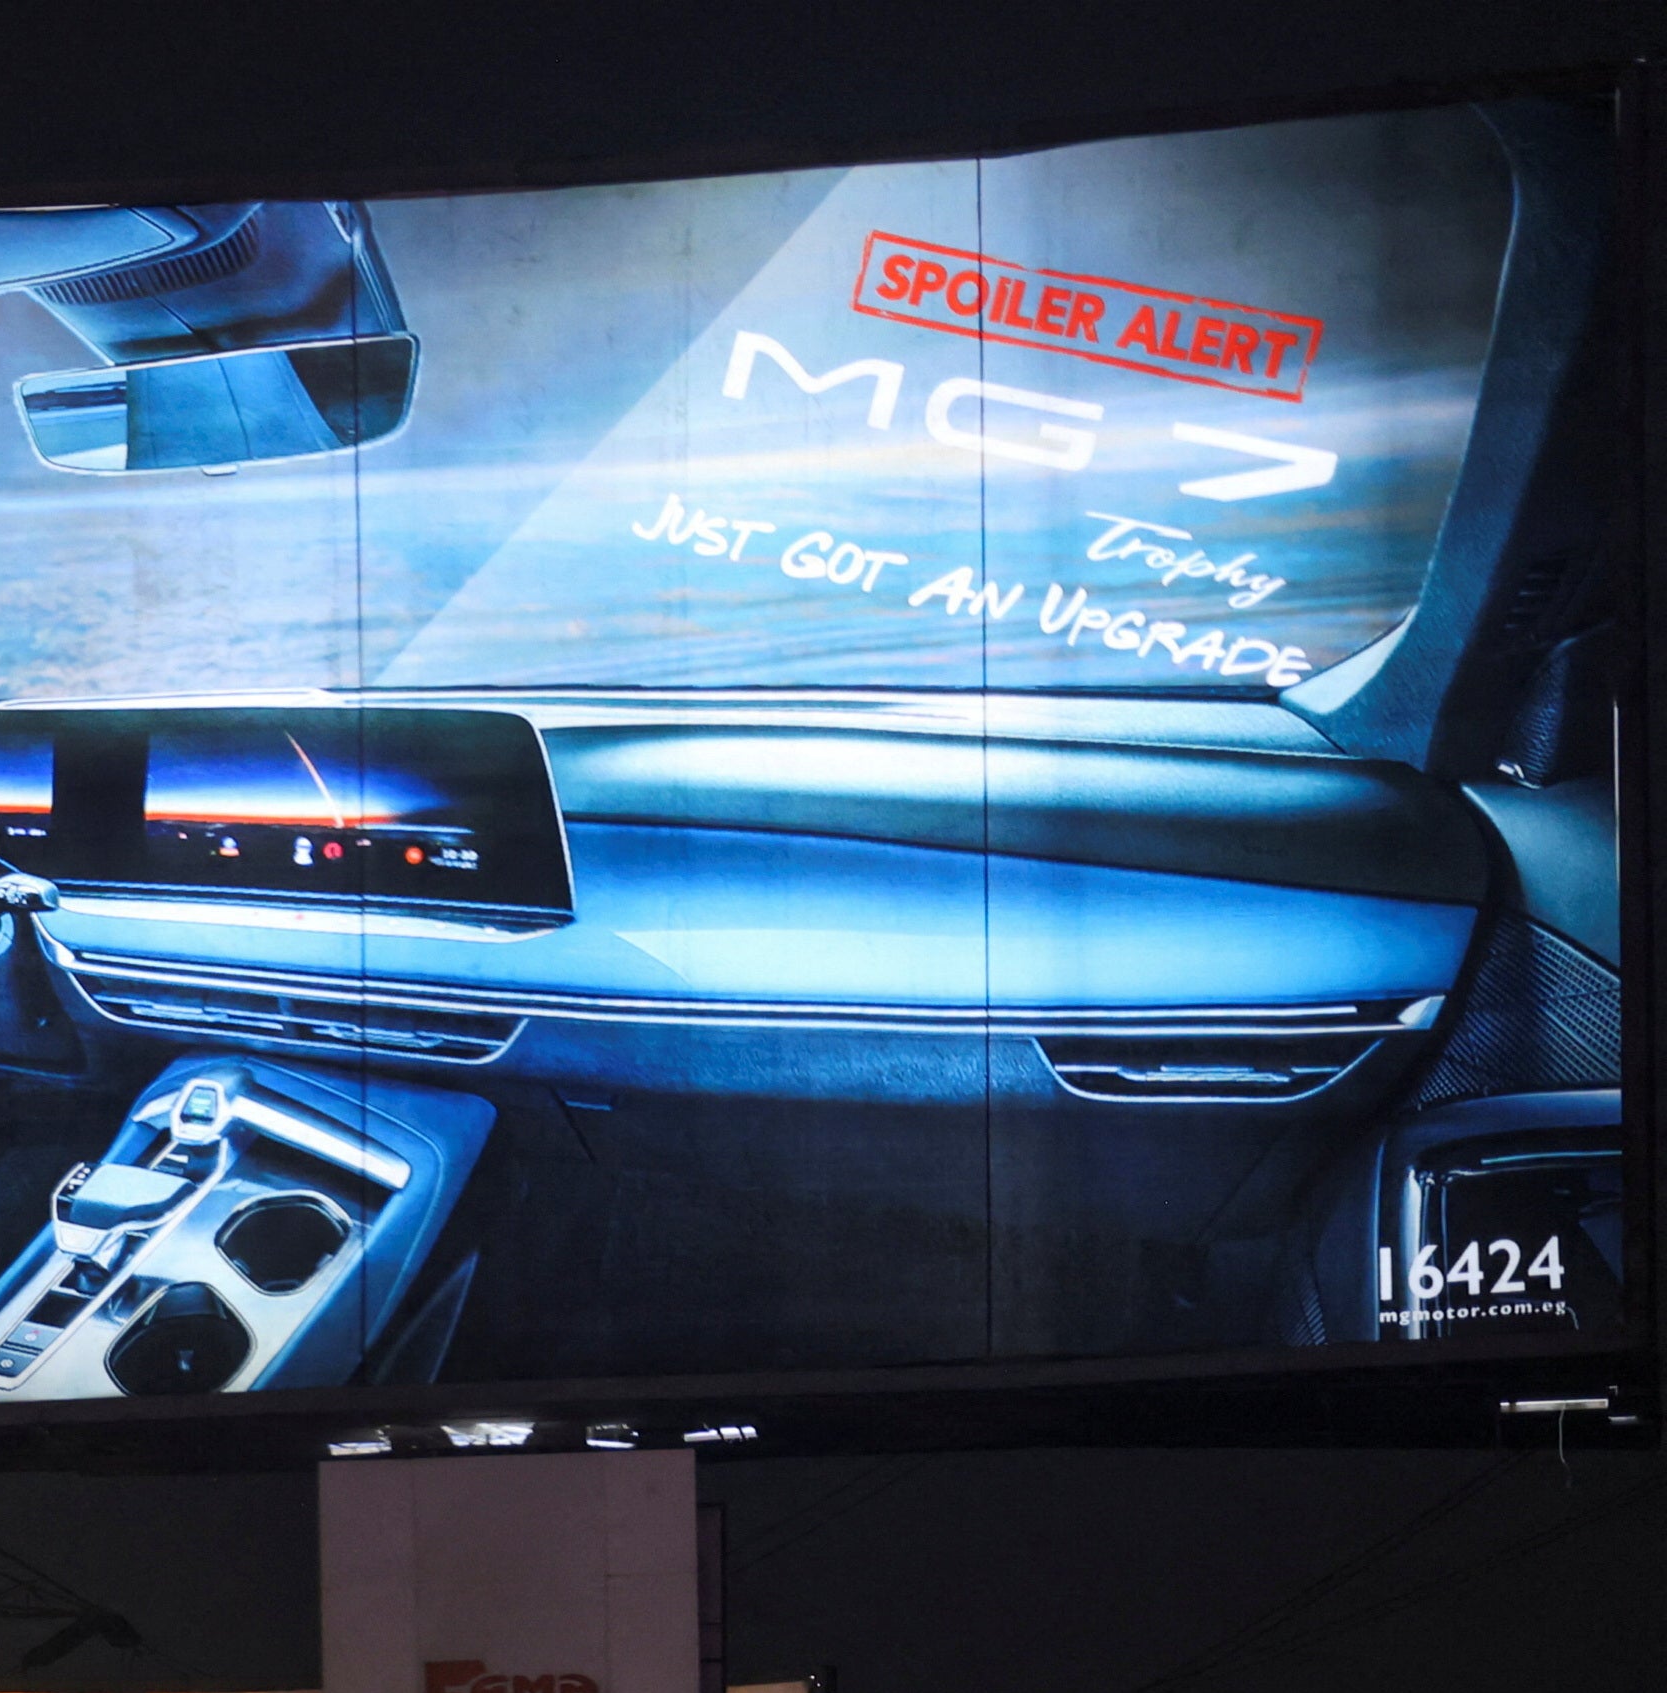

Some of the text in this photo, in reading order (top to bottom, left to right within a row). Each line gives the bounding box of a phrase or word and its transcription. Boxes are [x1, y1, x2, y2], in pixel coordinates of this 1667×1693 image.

[875, 253, 1299, 381] SPOILER ALERT
[631, 493, 1313, 689] JUST GOT AN UPGRADE
[1085, 510, 1289, 610] Trophy
[1379, 1235, 1565, 1301] 16424
[1379, 1301, 1566, 1326] mgmotor.com.eg
